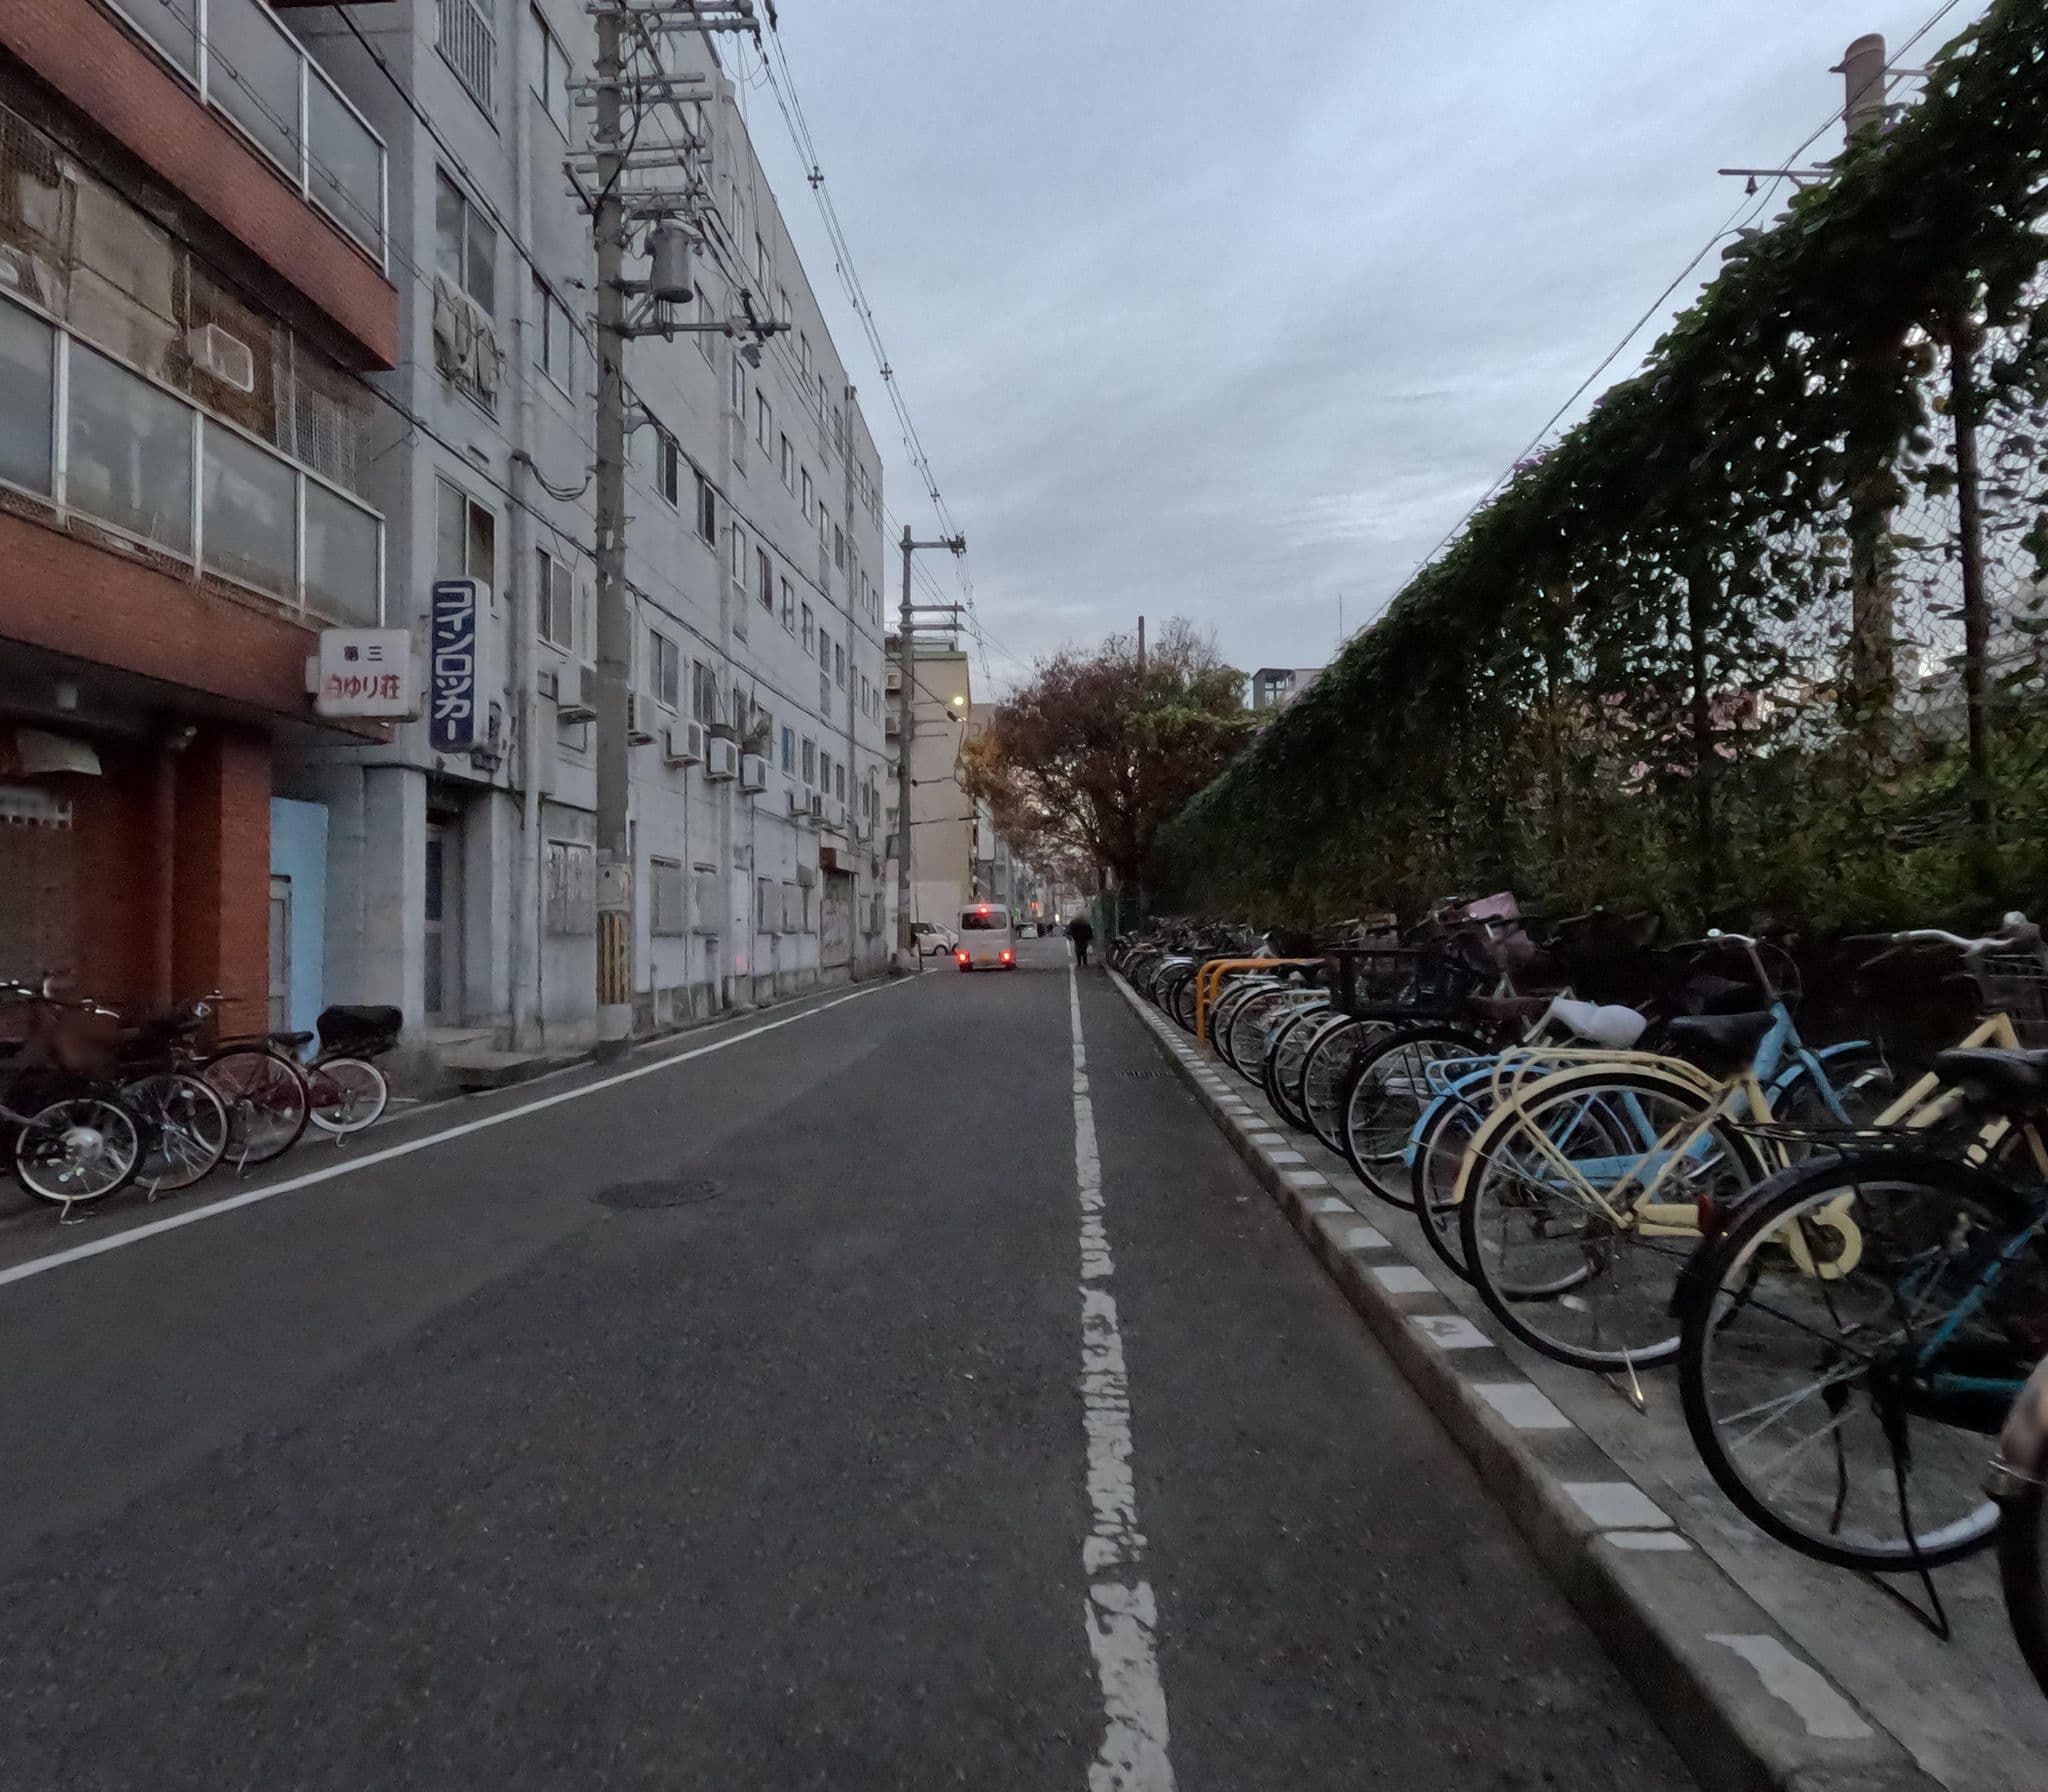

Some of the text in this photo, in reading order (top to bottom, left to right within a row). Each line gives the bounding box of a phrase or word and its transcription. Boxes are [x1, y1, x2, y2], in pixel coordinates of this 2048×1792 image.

[434, 586, 473, 741] コインロッカー
